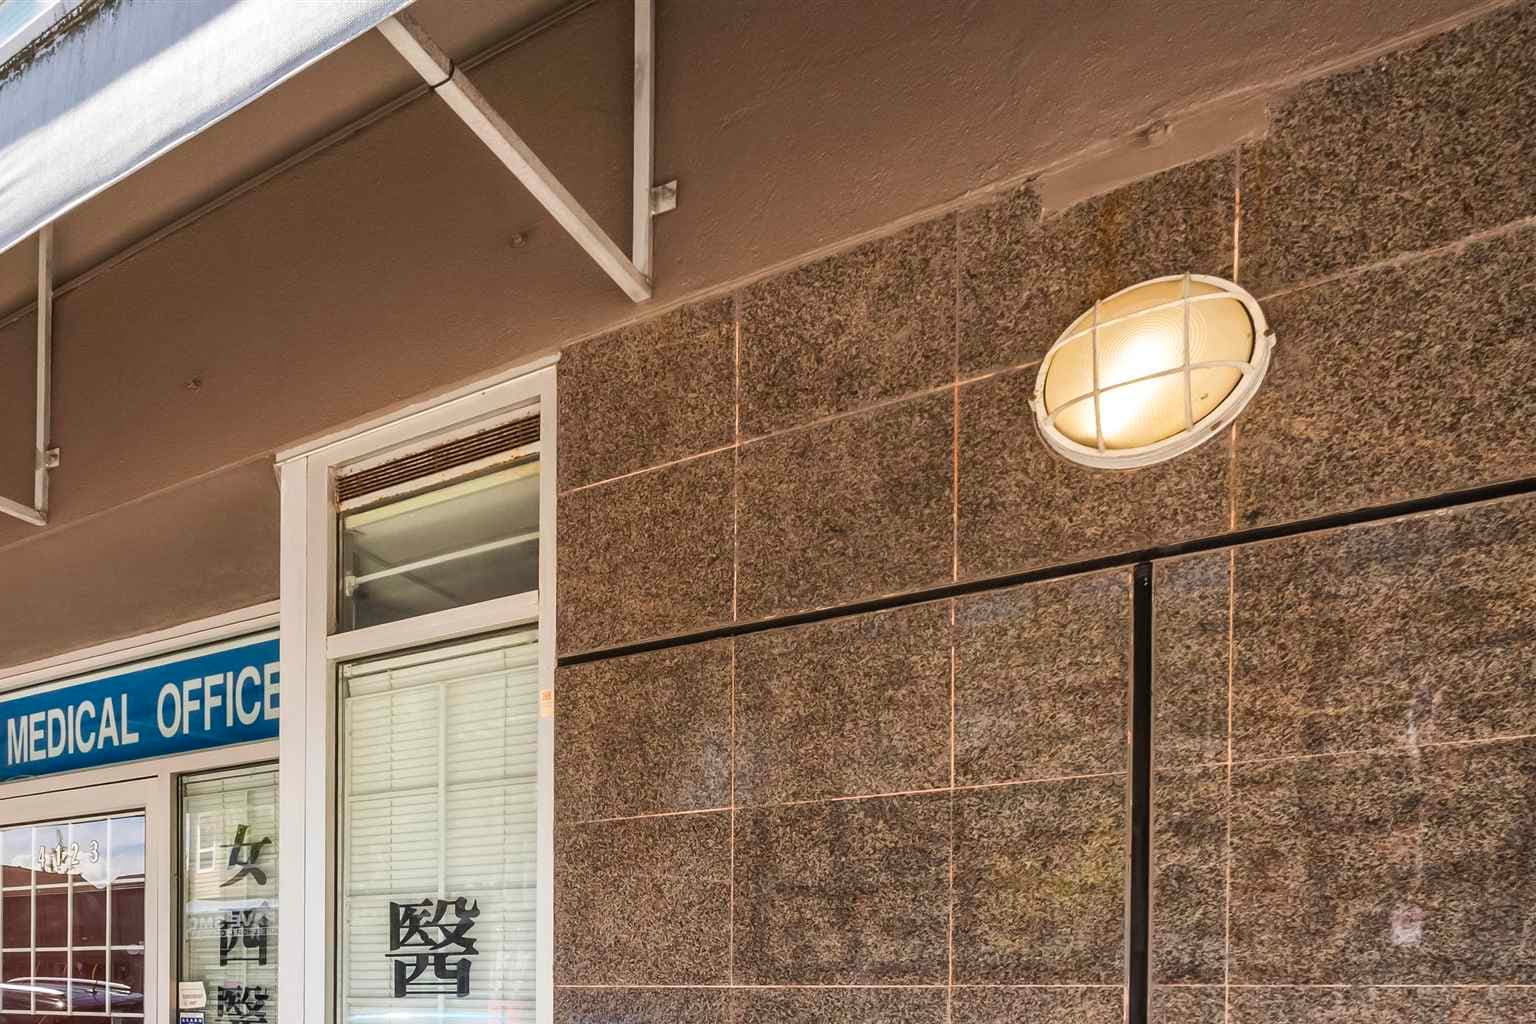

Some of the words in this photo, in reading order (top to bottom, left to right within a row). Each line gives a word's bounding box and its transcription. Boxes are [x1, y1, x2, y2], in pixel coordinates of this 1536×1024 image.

[6, 693, 140, 766] MEDICAL
[156, 660, 280, 738] OFFICE
[38, 839, 99, 871] 4123
